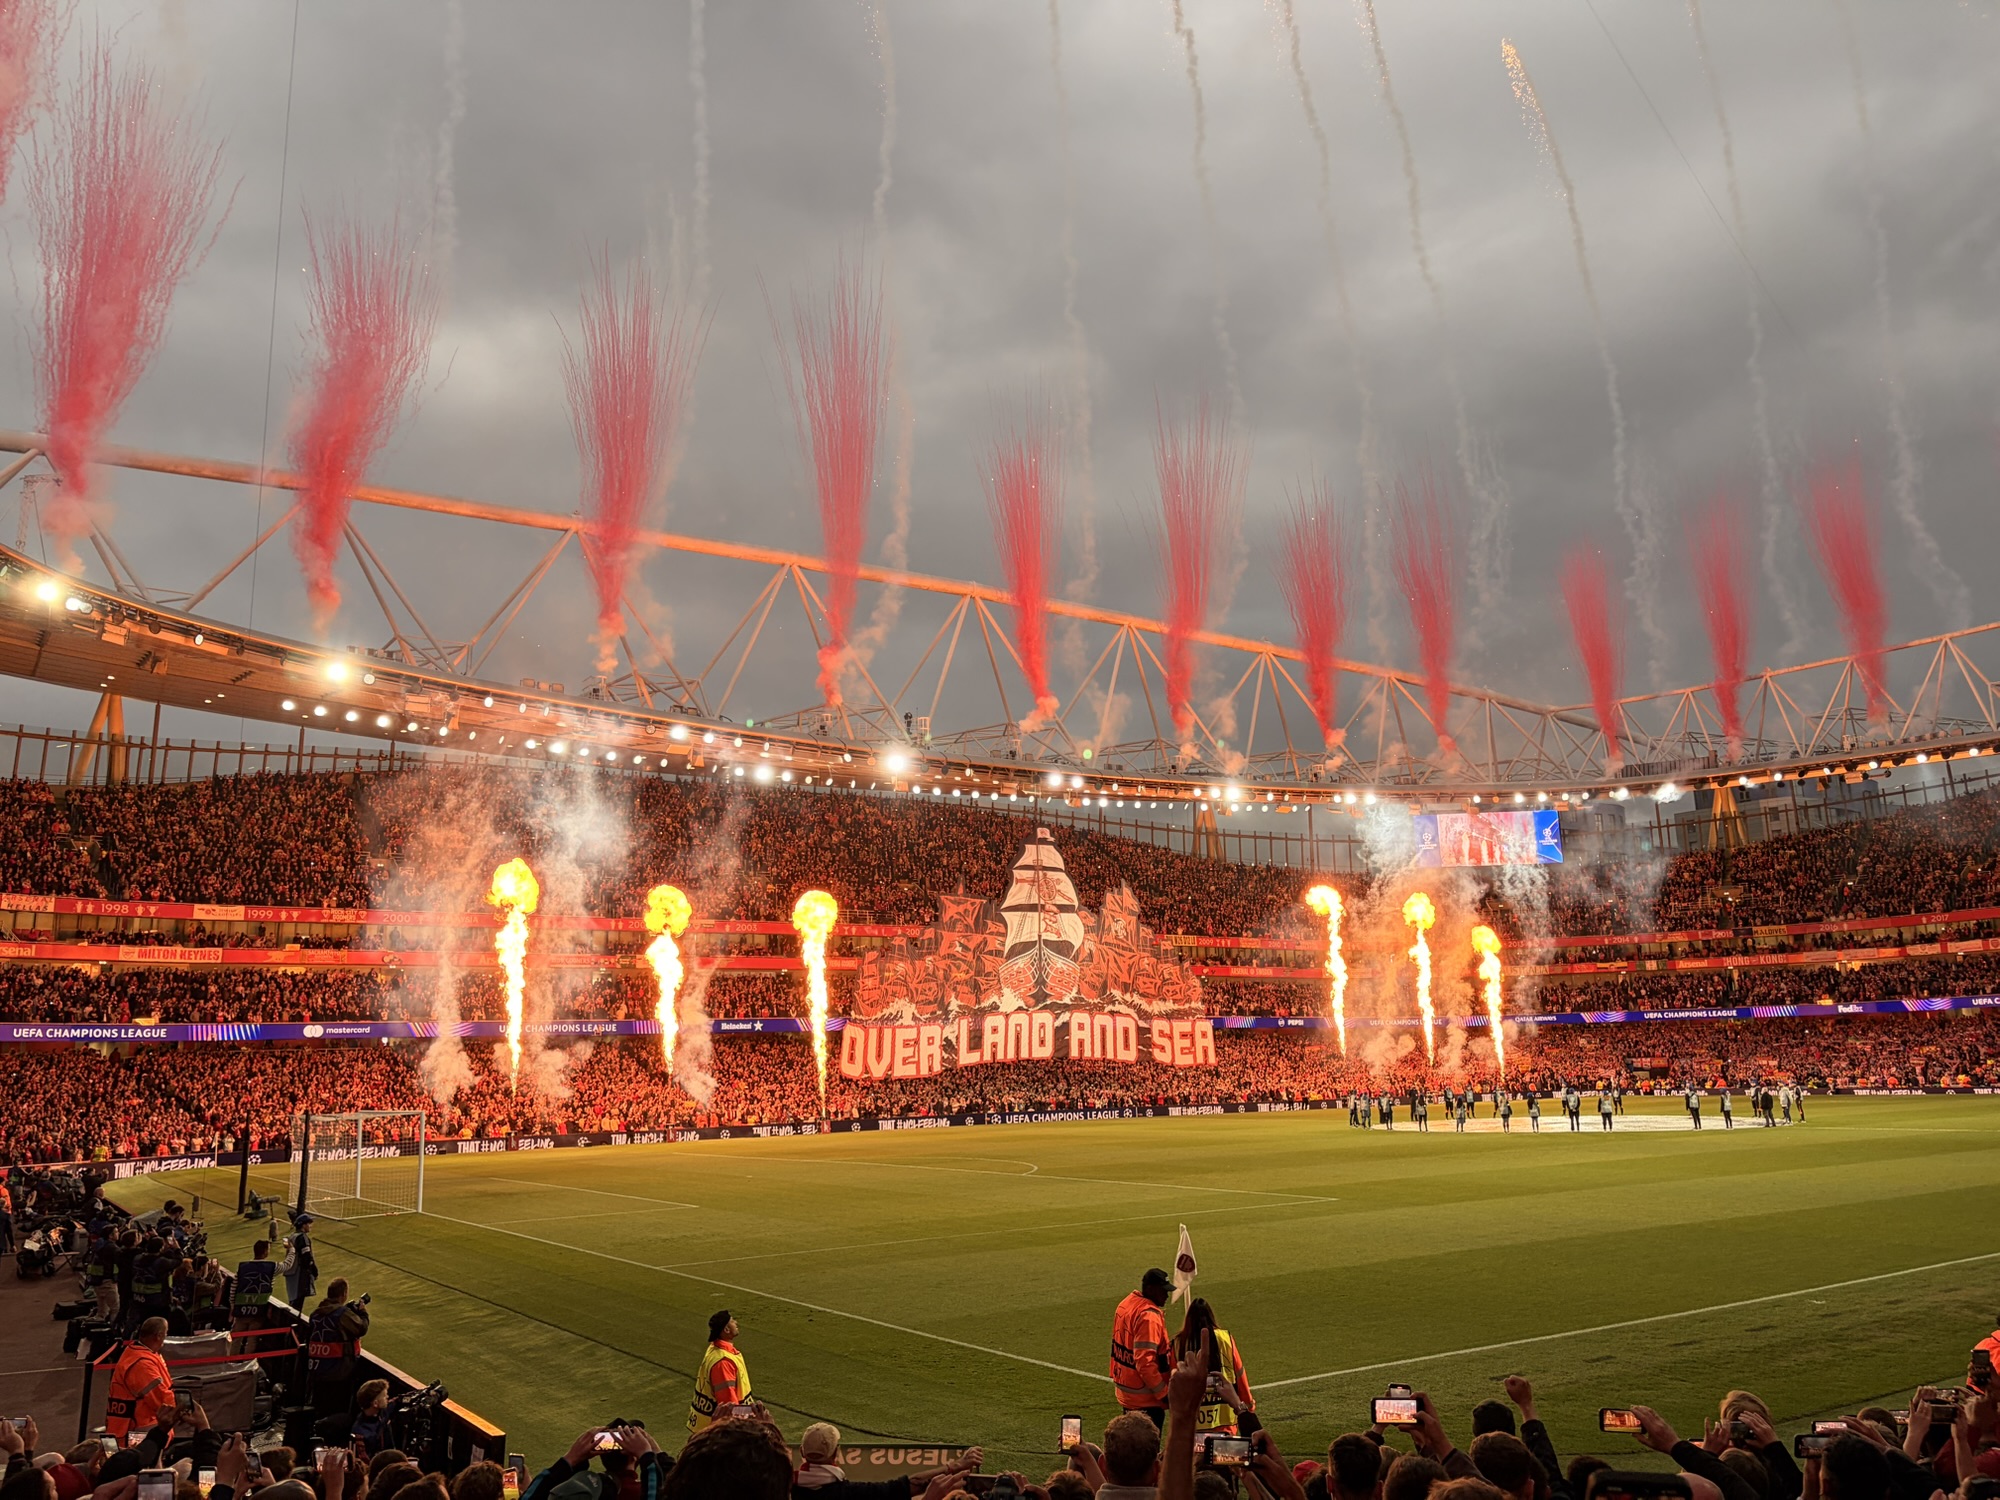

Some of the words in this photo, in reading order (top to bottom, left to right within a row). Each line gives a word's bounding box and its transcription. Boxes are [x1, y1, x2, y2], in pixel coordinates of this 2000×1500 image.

[7, 903, 48, 911] HELLAS
[101, 904, 129, 914] 1998
[247, 909, 274, 919] 1999
[383, 914, 411, 923] 2000
[1931, 914, 1949, 922] 2017
[628, 920, 645, 929] 200
[736, 924, 757, 932] 2003
[906, 928, 920, 936] 200
[1753, 928, 1787, 936] MALDIVES
[1199, 937, 1213, 945] 2009
[0, 945, 36, 957] rsenal
[138, 949, 178, 960] MILTON
[179, 949, 220, 960] KEYNES
[1678, 960, 1708, 968] Arsenal
[1726, 956, 1750, 966] HONG
[1759, 955, 1784, 964] KONG
[1838, 1005, 1864, 1013] FedEx
[326, 1026, 371, 1034] mastercard
[525, 1024, 580, 1033] CHAMPIONS
[582, 1023, 617, 1032] LEAGUE
[721, 1022, 752, 1031] Heineken
[13, 1028, 43, 1038] UEFA
[45, 1028, 119, 1038] CHAMPIONS
[120, 1028, 167, 1038] LEAGUE
[840, 1022, 944, 1080] OVER
[958, 1011, 1055, 1067] LAND
[1069, 1010, 1139, 1064] AND
[1151, 1016, 1218, 1067] SEA
[1005, 1114, 1029, 1124] UEFA
[1031, 1111, 1084, 1123] CHAMPIONS
[1086, 1109, 1120, 1120] LEAGUE
[878, 1120, 895, 1131] THAT
[753, 1126, 771, 1138] THAT
[457, 1140, 481, 1154] THAT
[290, 1149, 316, 1163] THT
[114, 1162, 136, 1179] THAT
[244, 1294, 258, 1303] TV
[240, 1306, 258, 1316] 970
[309, 1343, 331, 1356] OTO
